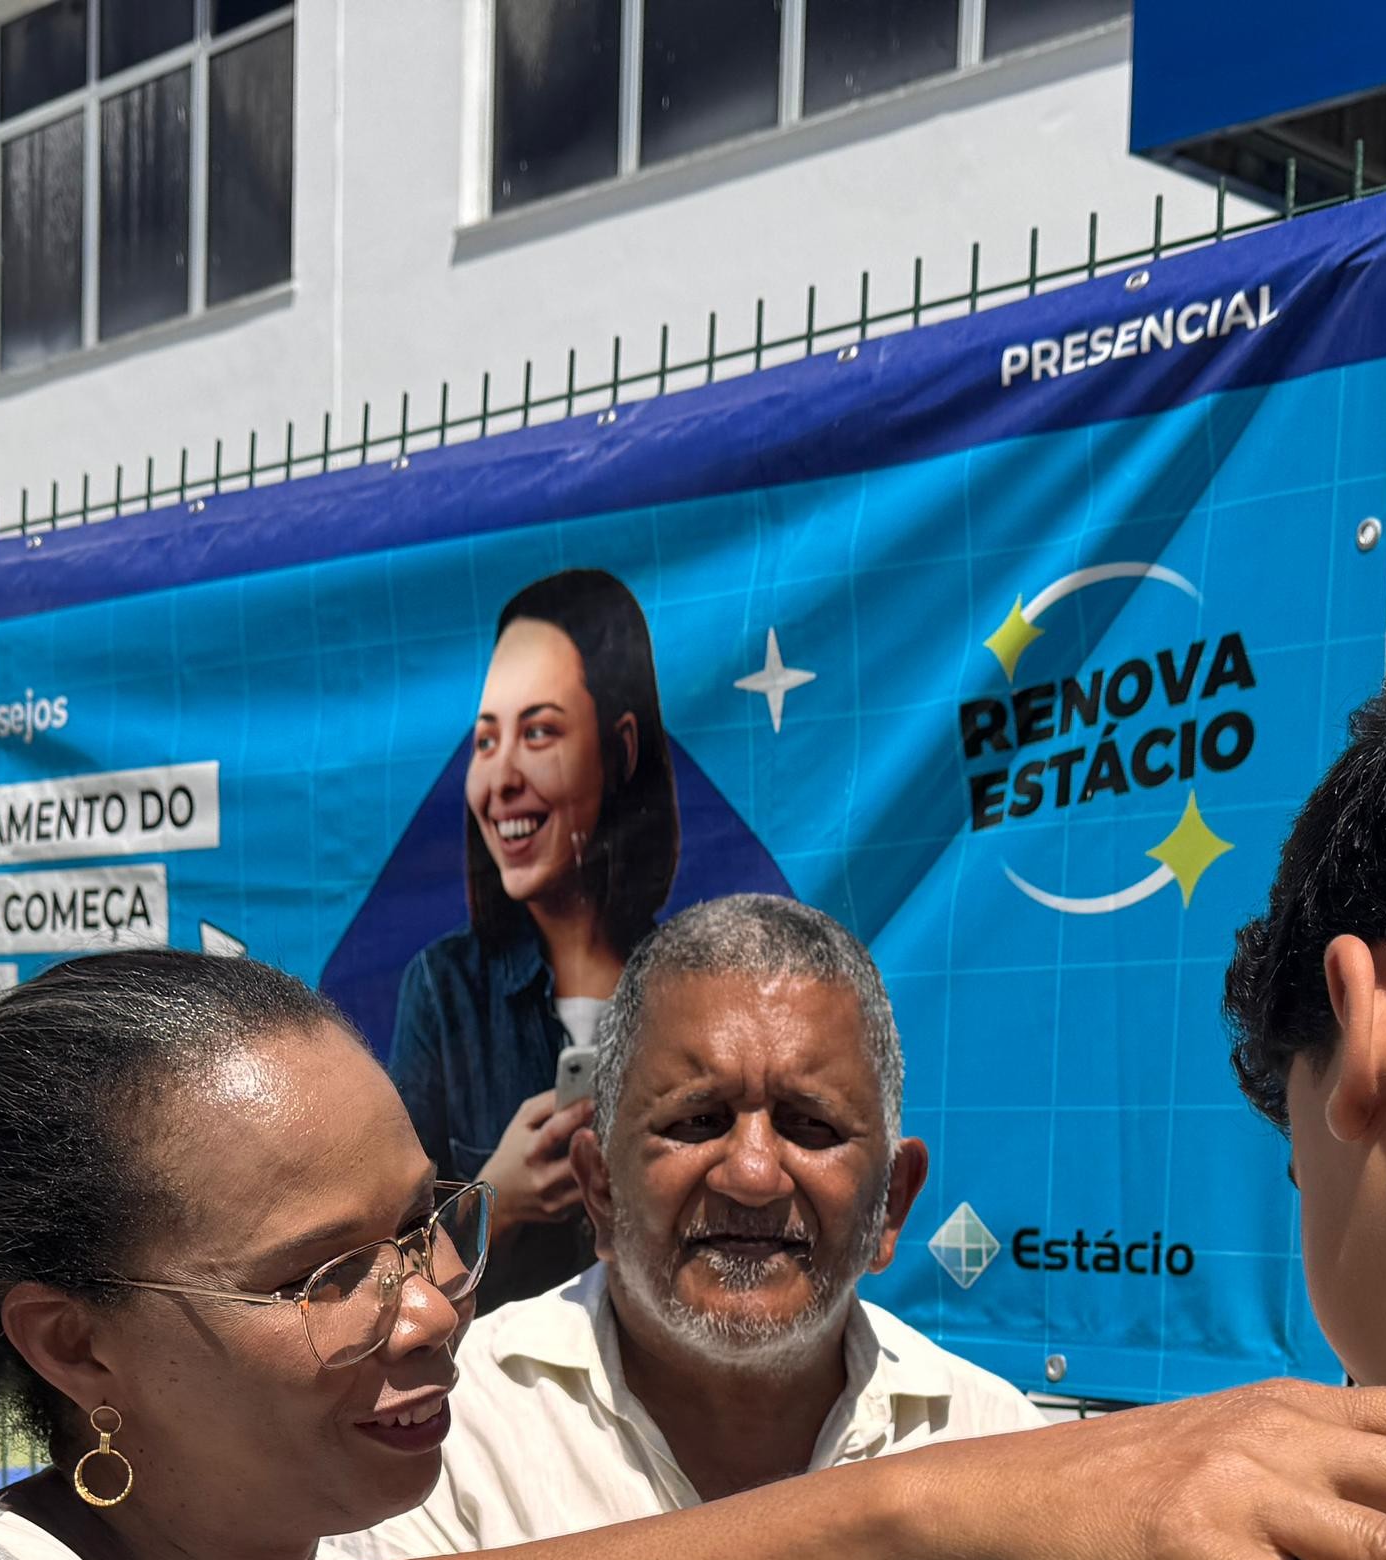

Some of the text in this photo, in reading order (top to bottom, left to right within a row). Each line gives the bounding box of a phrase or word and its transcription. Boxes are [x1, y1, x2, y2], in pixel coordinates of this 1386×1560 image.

[1001, 284, 1279, 387] PRESENCIAL
[959, 632, 1256, 759] RENOVA
[139, 785, 195, 830] DO
[970, 710, 1256, 833] ESTÁCIO
[4, 885, 151, 943] COMEÇA
[1012, 1227, 1195, 1276] Estácio
